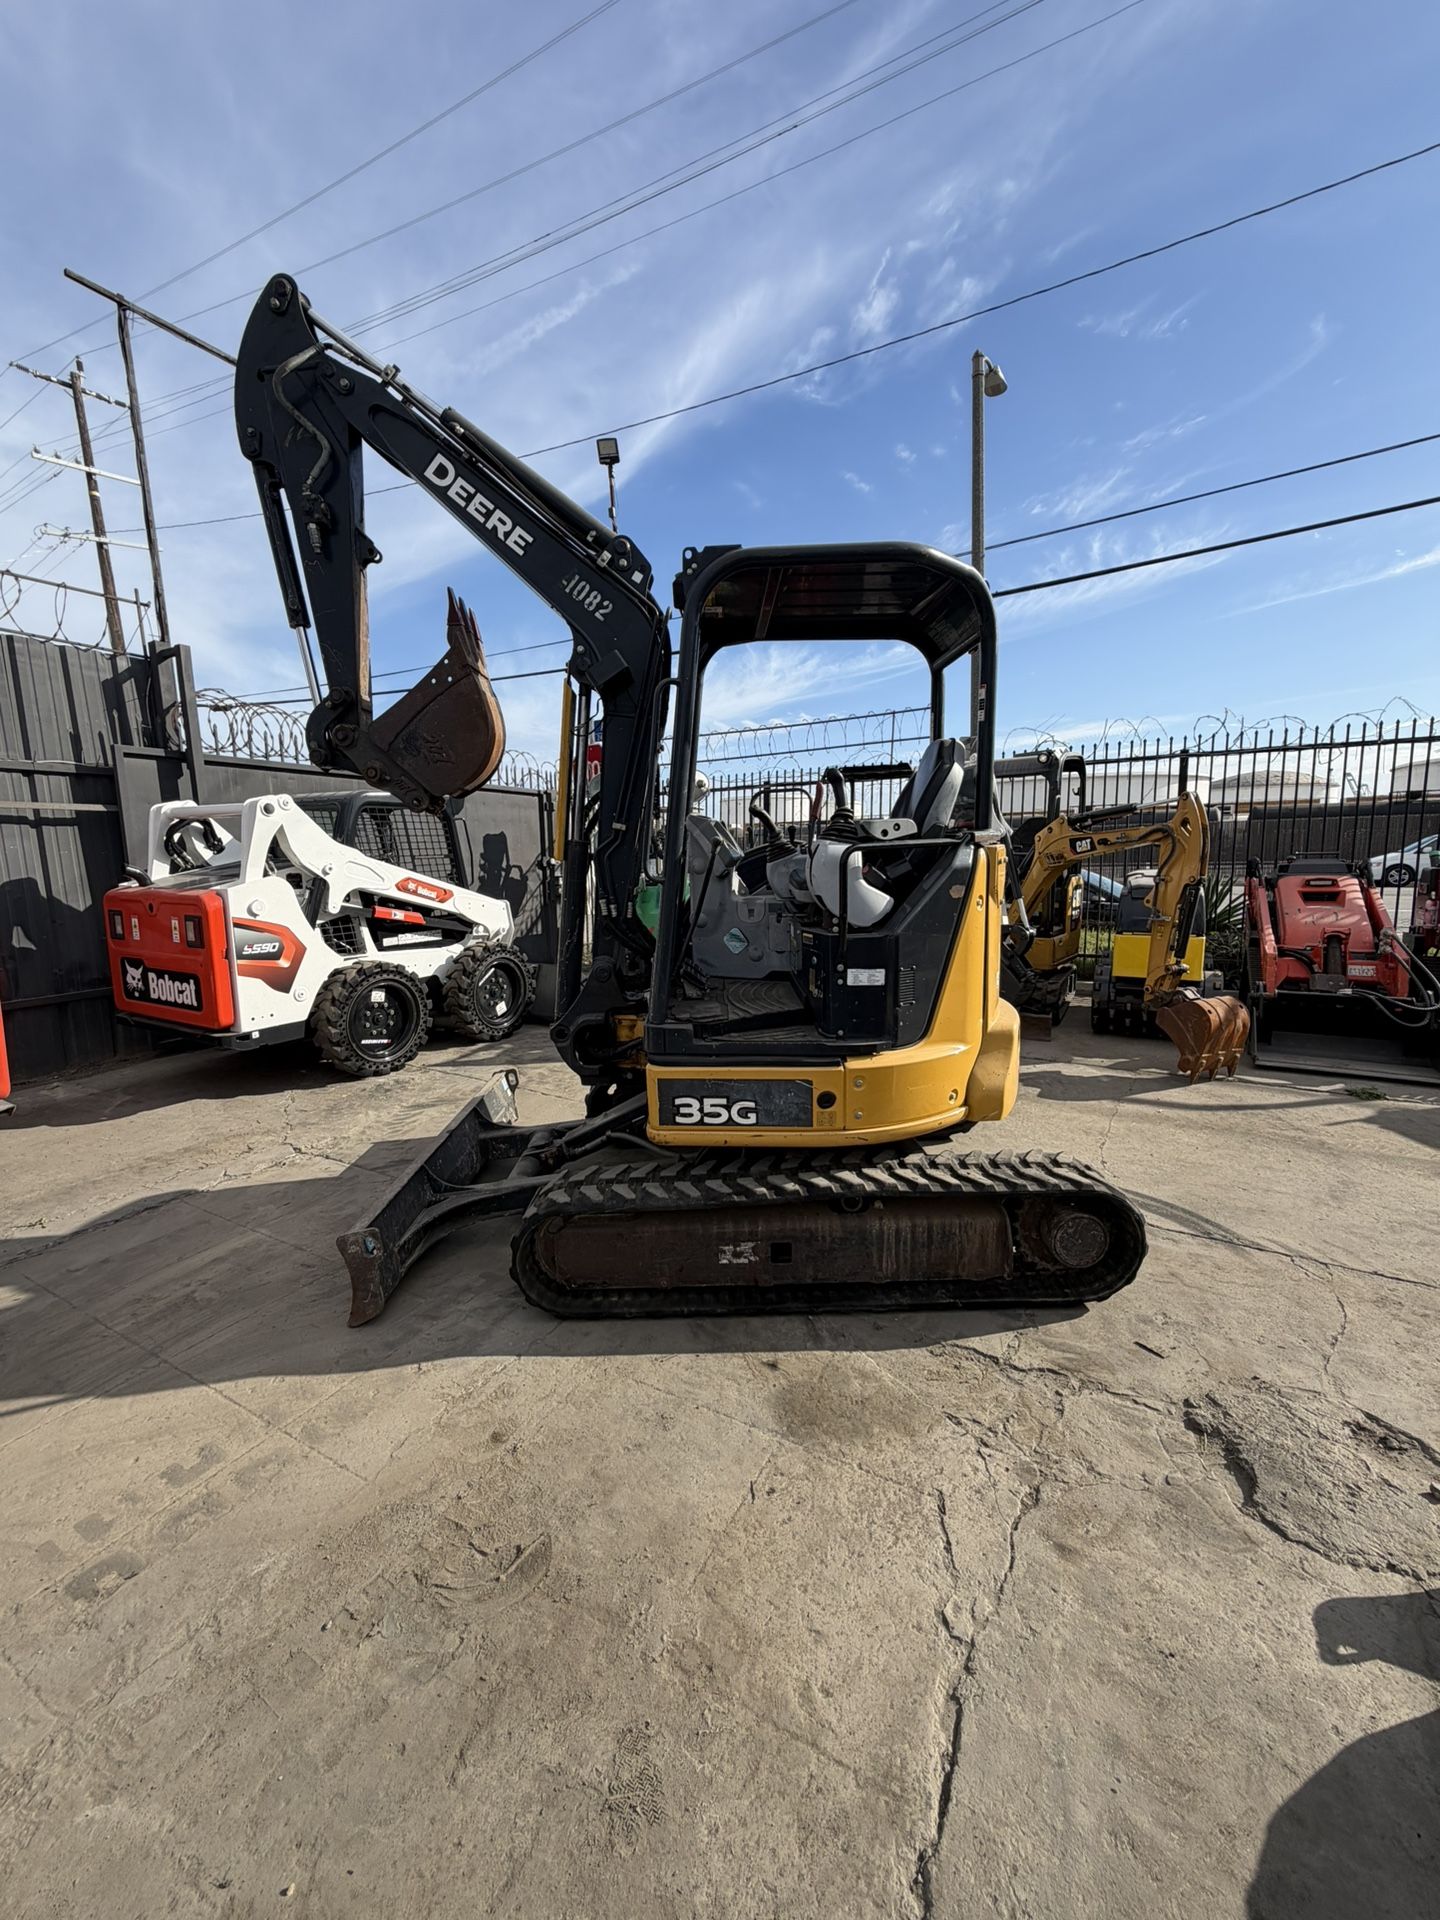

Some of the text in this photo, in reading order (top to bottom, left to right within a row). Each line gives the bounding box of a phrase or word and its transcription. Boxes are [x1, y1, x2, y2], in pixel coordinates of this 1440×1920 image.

[423, 452, 534, 557] DEERE
[1076, 839, 1092, 853] CAT
[242, 942, 280, 955] S590
[148, 971, 198, 1007] Bobcat
[674, 1097, 757, 1125] 35G
